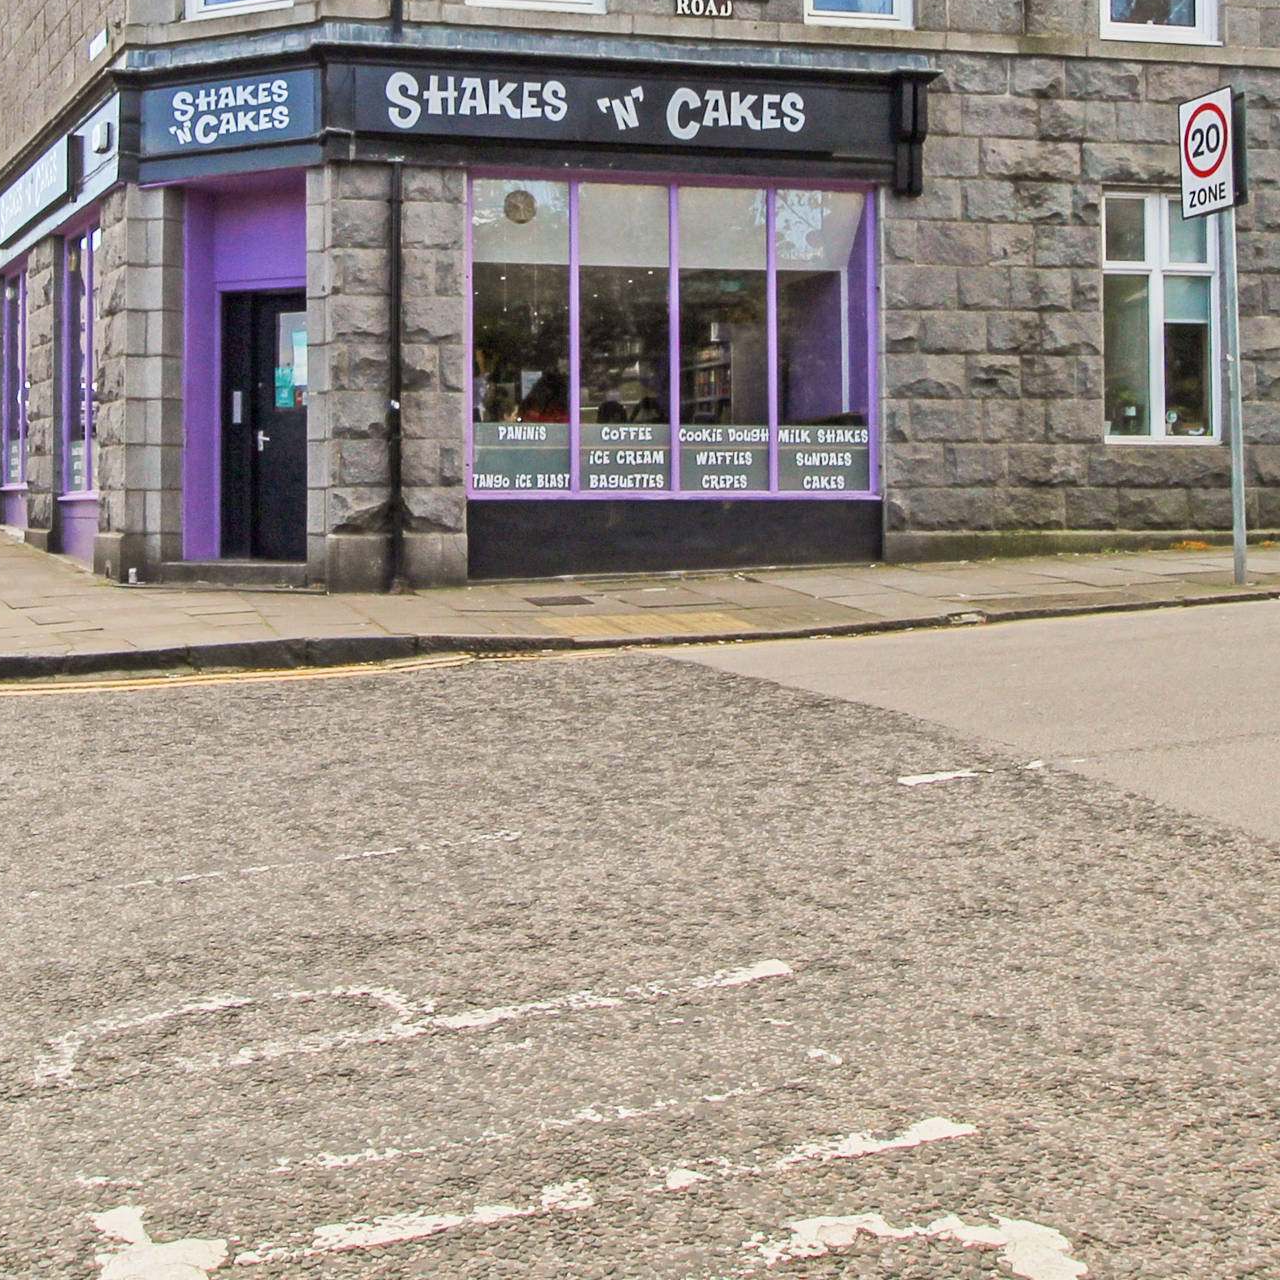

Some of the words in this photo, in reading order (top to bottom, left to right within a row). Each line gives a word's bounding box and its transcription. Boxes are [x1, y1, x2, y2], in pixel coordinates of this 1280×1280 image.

[172, 79, 289, 122] SHAKES
[385, 71, 568, 129] SHAKES
[666, 86, 806, 140] CAKES
[195, 105, 290, 144] CAKES
[1191, 123, 1220, 158] 20
[1189, 181, 1226, 209] ZONE
[817, 428, 869, 443] SHAKES
[616, 450, 664, 465] CREAM
[696, 451, 753, 466] WAFFLES
[536, 474, 570, 489] BLAST
[701, 474, 748, 489] CREPES
[803, 475, 845, 490] CAKES
